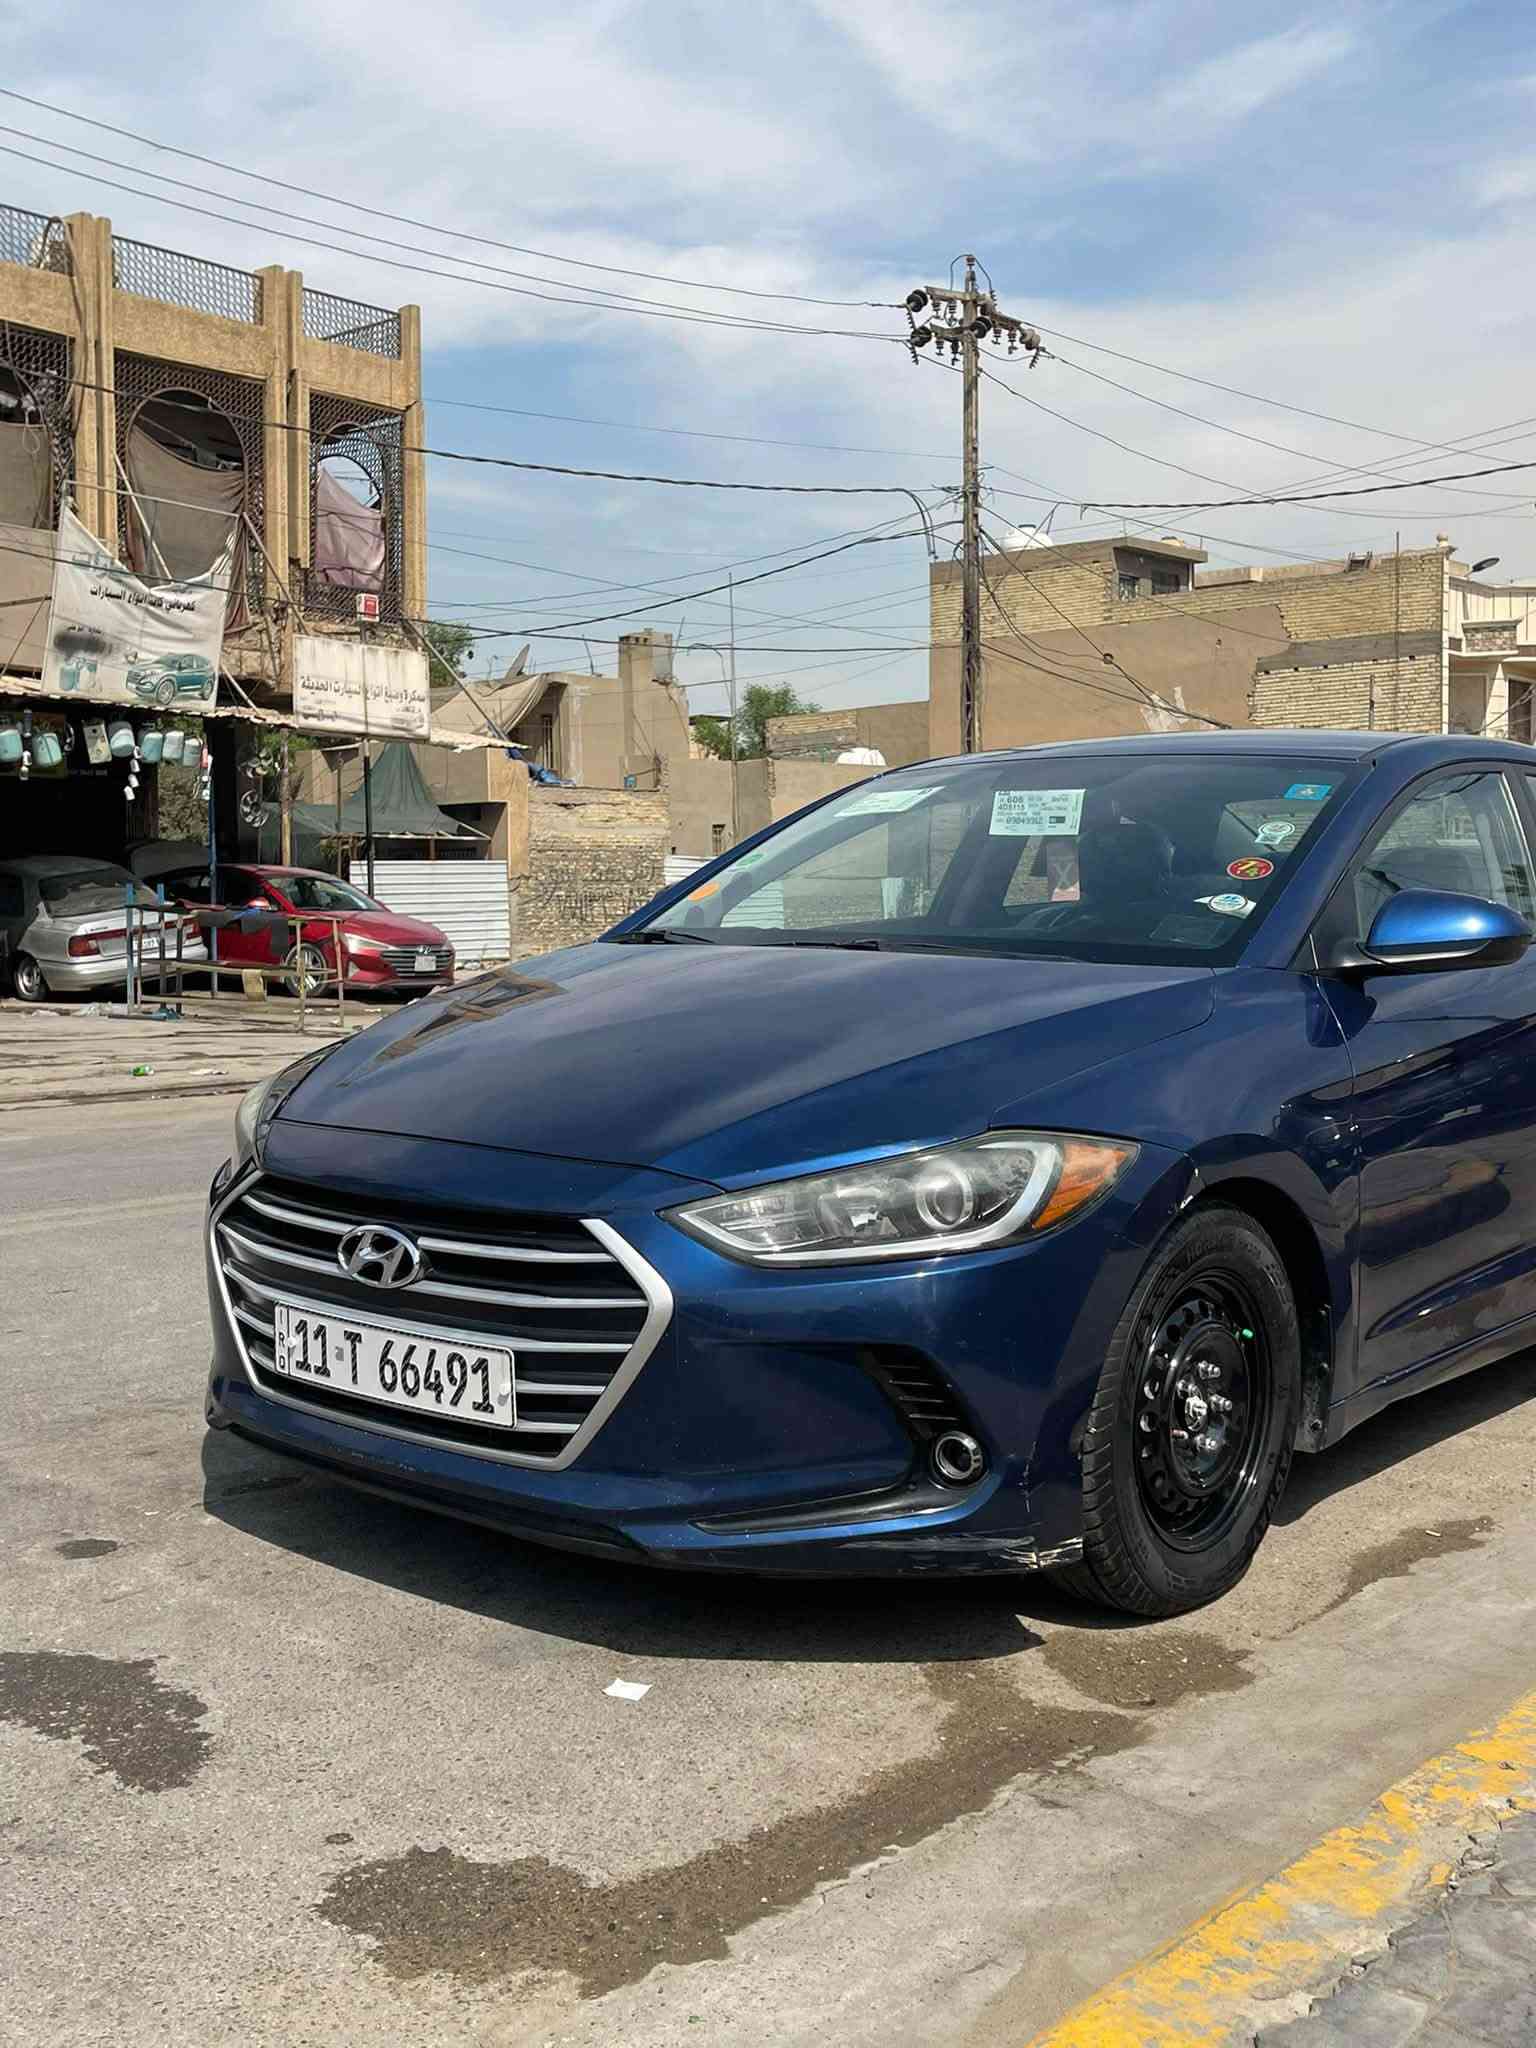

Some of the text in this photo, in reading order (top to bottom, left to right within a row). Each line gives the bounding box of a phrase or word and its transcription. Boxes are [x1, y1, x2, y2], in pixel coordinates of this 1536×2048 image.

[90, 585, 126, 600] السيارات
[300, 675, 332, 695] الحديثة
[295, 1319, 495, 1414] 11 T 66491
